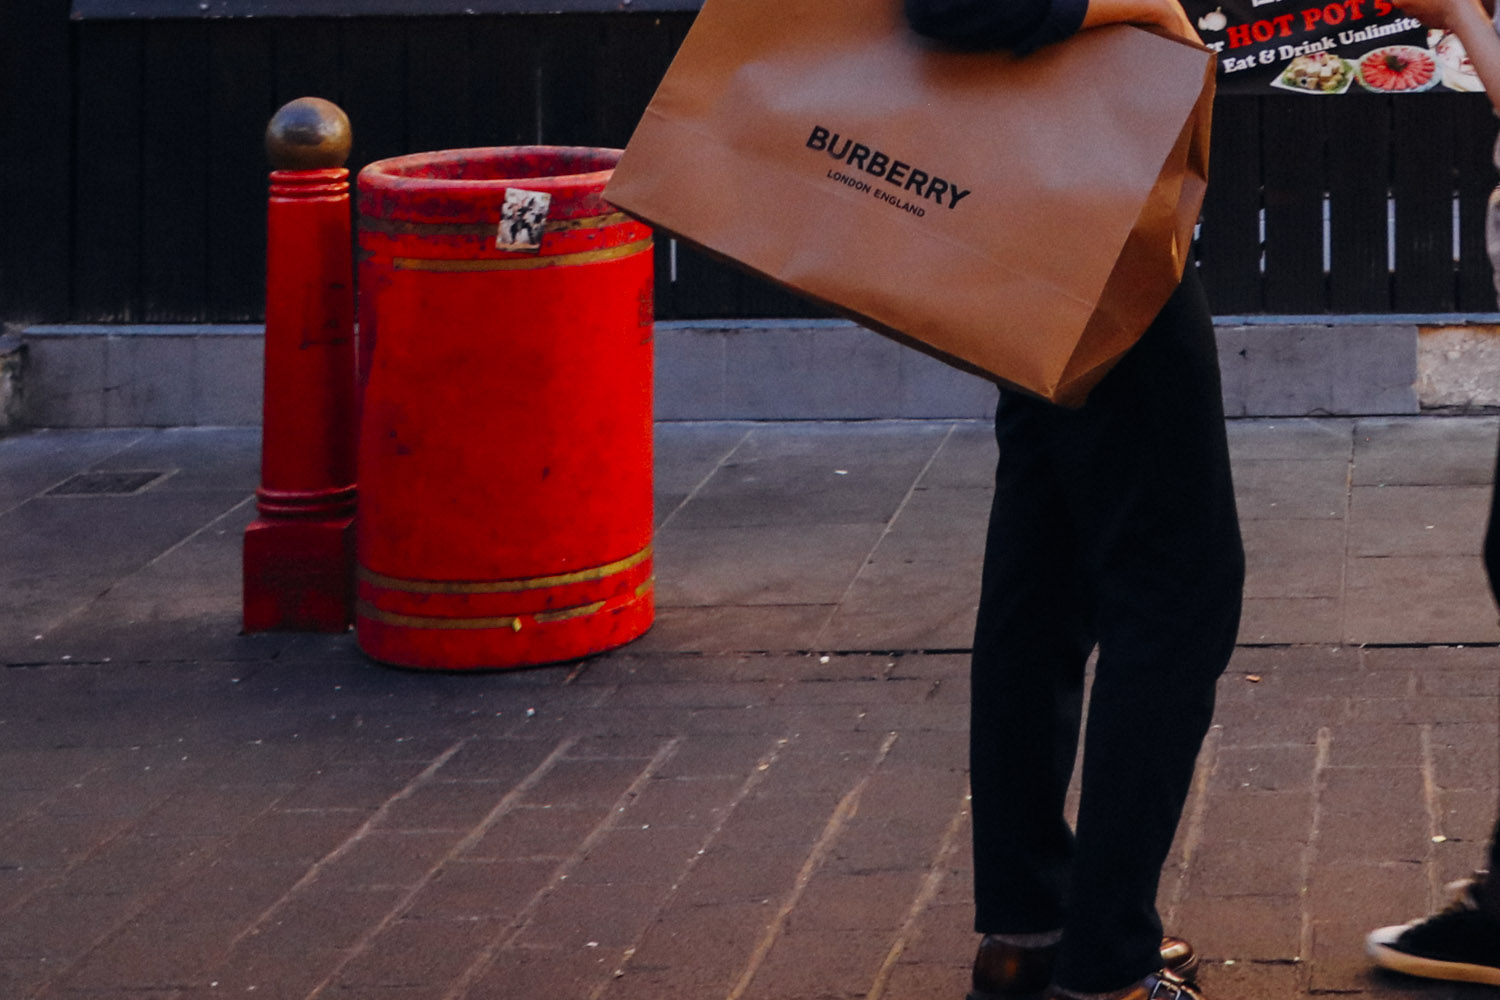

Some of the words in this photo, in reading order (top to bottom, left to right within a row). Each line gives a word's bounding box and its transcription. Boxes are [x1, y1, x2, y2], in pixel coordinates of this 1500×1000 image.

[1222, 52, 1258, 74] Eat
[1259, 49, 1277, 65] &
[1279, 36, 1338, 61] Drink
[1338, 17, 1422, 45] Unlimite
[1226, 13, 1295, 49] HOT
[806, 125, 971, 210] BURBERRY
[826, 169, 872, 194] LONDON
[874, 188, 926, 218] ENGLAND
